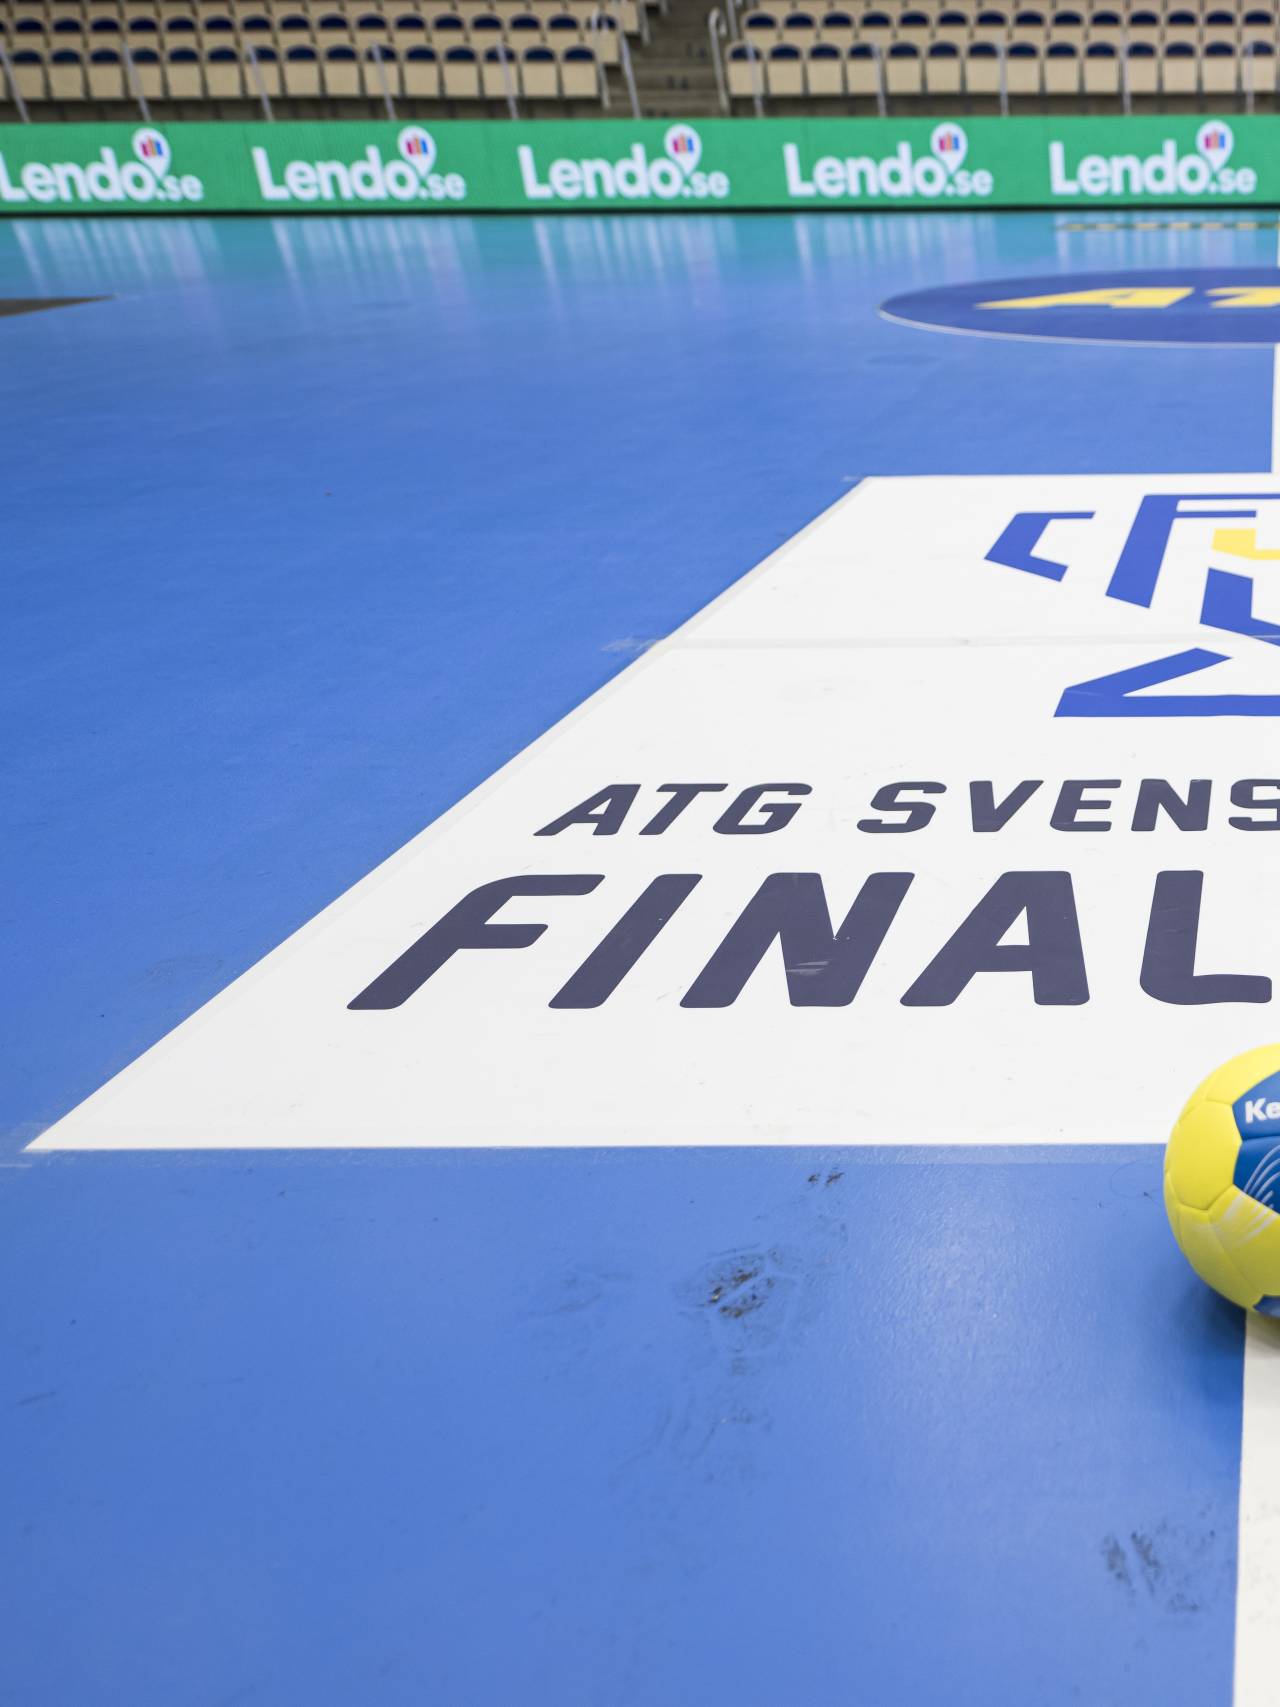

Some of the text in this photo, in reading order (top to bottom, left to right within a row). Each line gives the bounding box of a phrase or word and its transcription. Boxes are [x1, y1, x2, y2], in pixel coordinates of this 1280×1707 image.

[251, 144, 466, 201] Lendo.se
[517, 142, 729, 199] Lendo.se
[782, 140, 993, 198] Lendo.se
[1048, 138, 1257, 196] Lendo.se
[534, 783, 813, 837] ATG
[346, 869, 1273, 1011] FINAL
